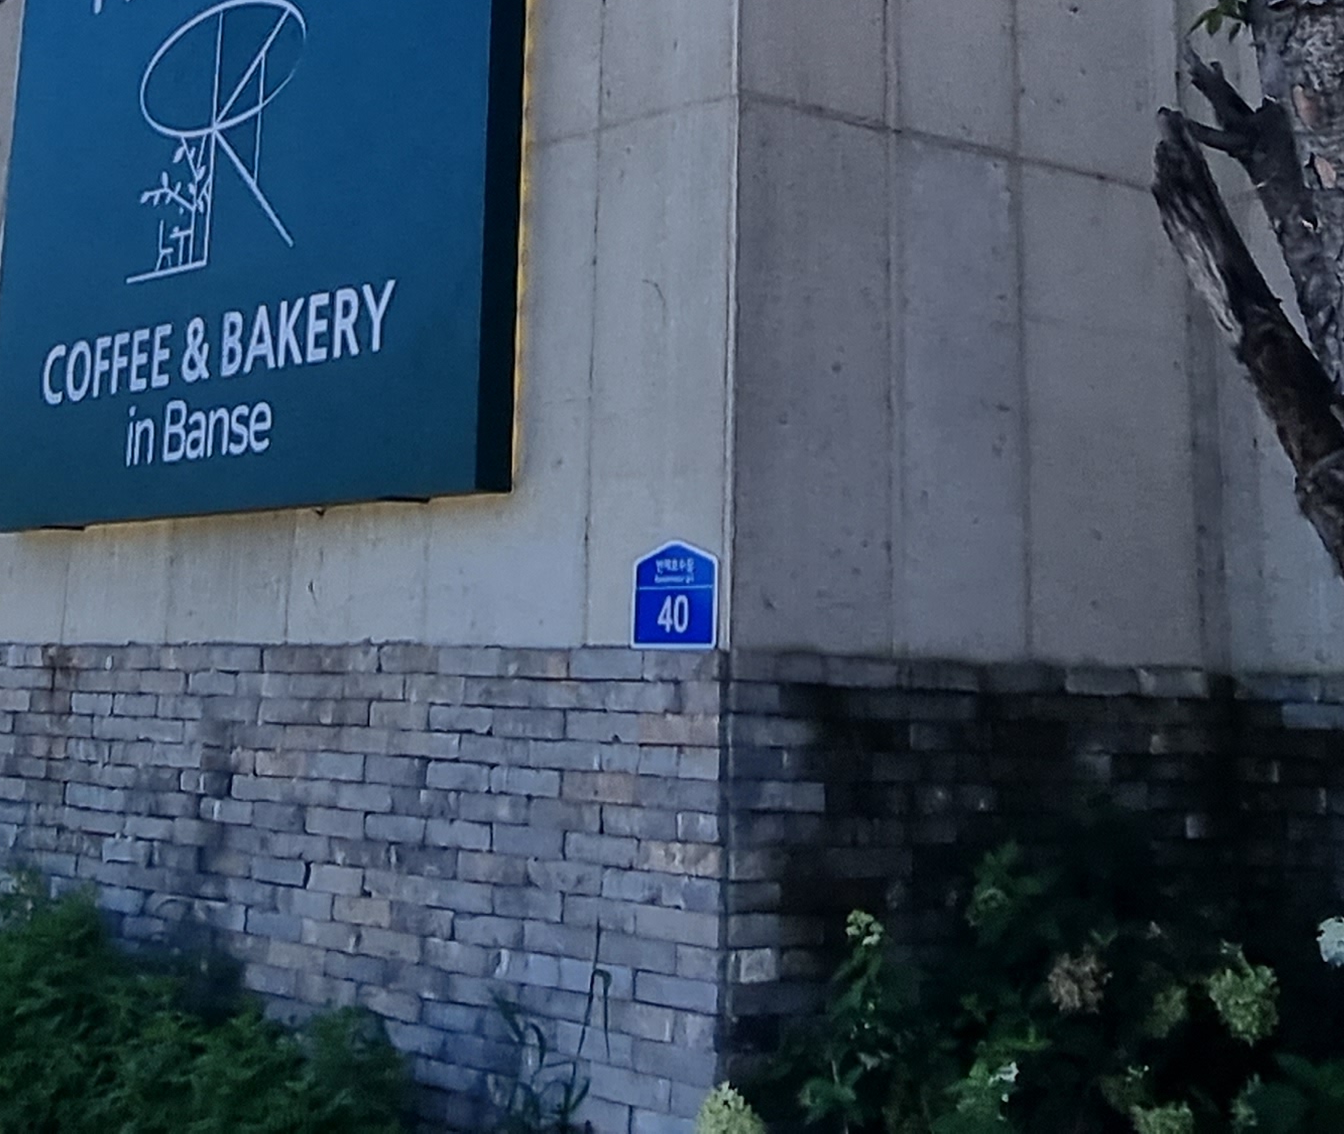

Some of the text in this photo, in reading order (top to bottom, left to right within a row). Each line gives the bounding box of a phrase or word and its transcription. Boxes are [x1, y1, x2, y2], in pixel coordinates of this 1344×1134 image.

[41, 279, 396, 406] COFFEE & BAKERY
[125, 399, 273, 467] in Banse
[657, 594, 690, 634] 40
